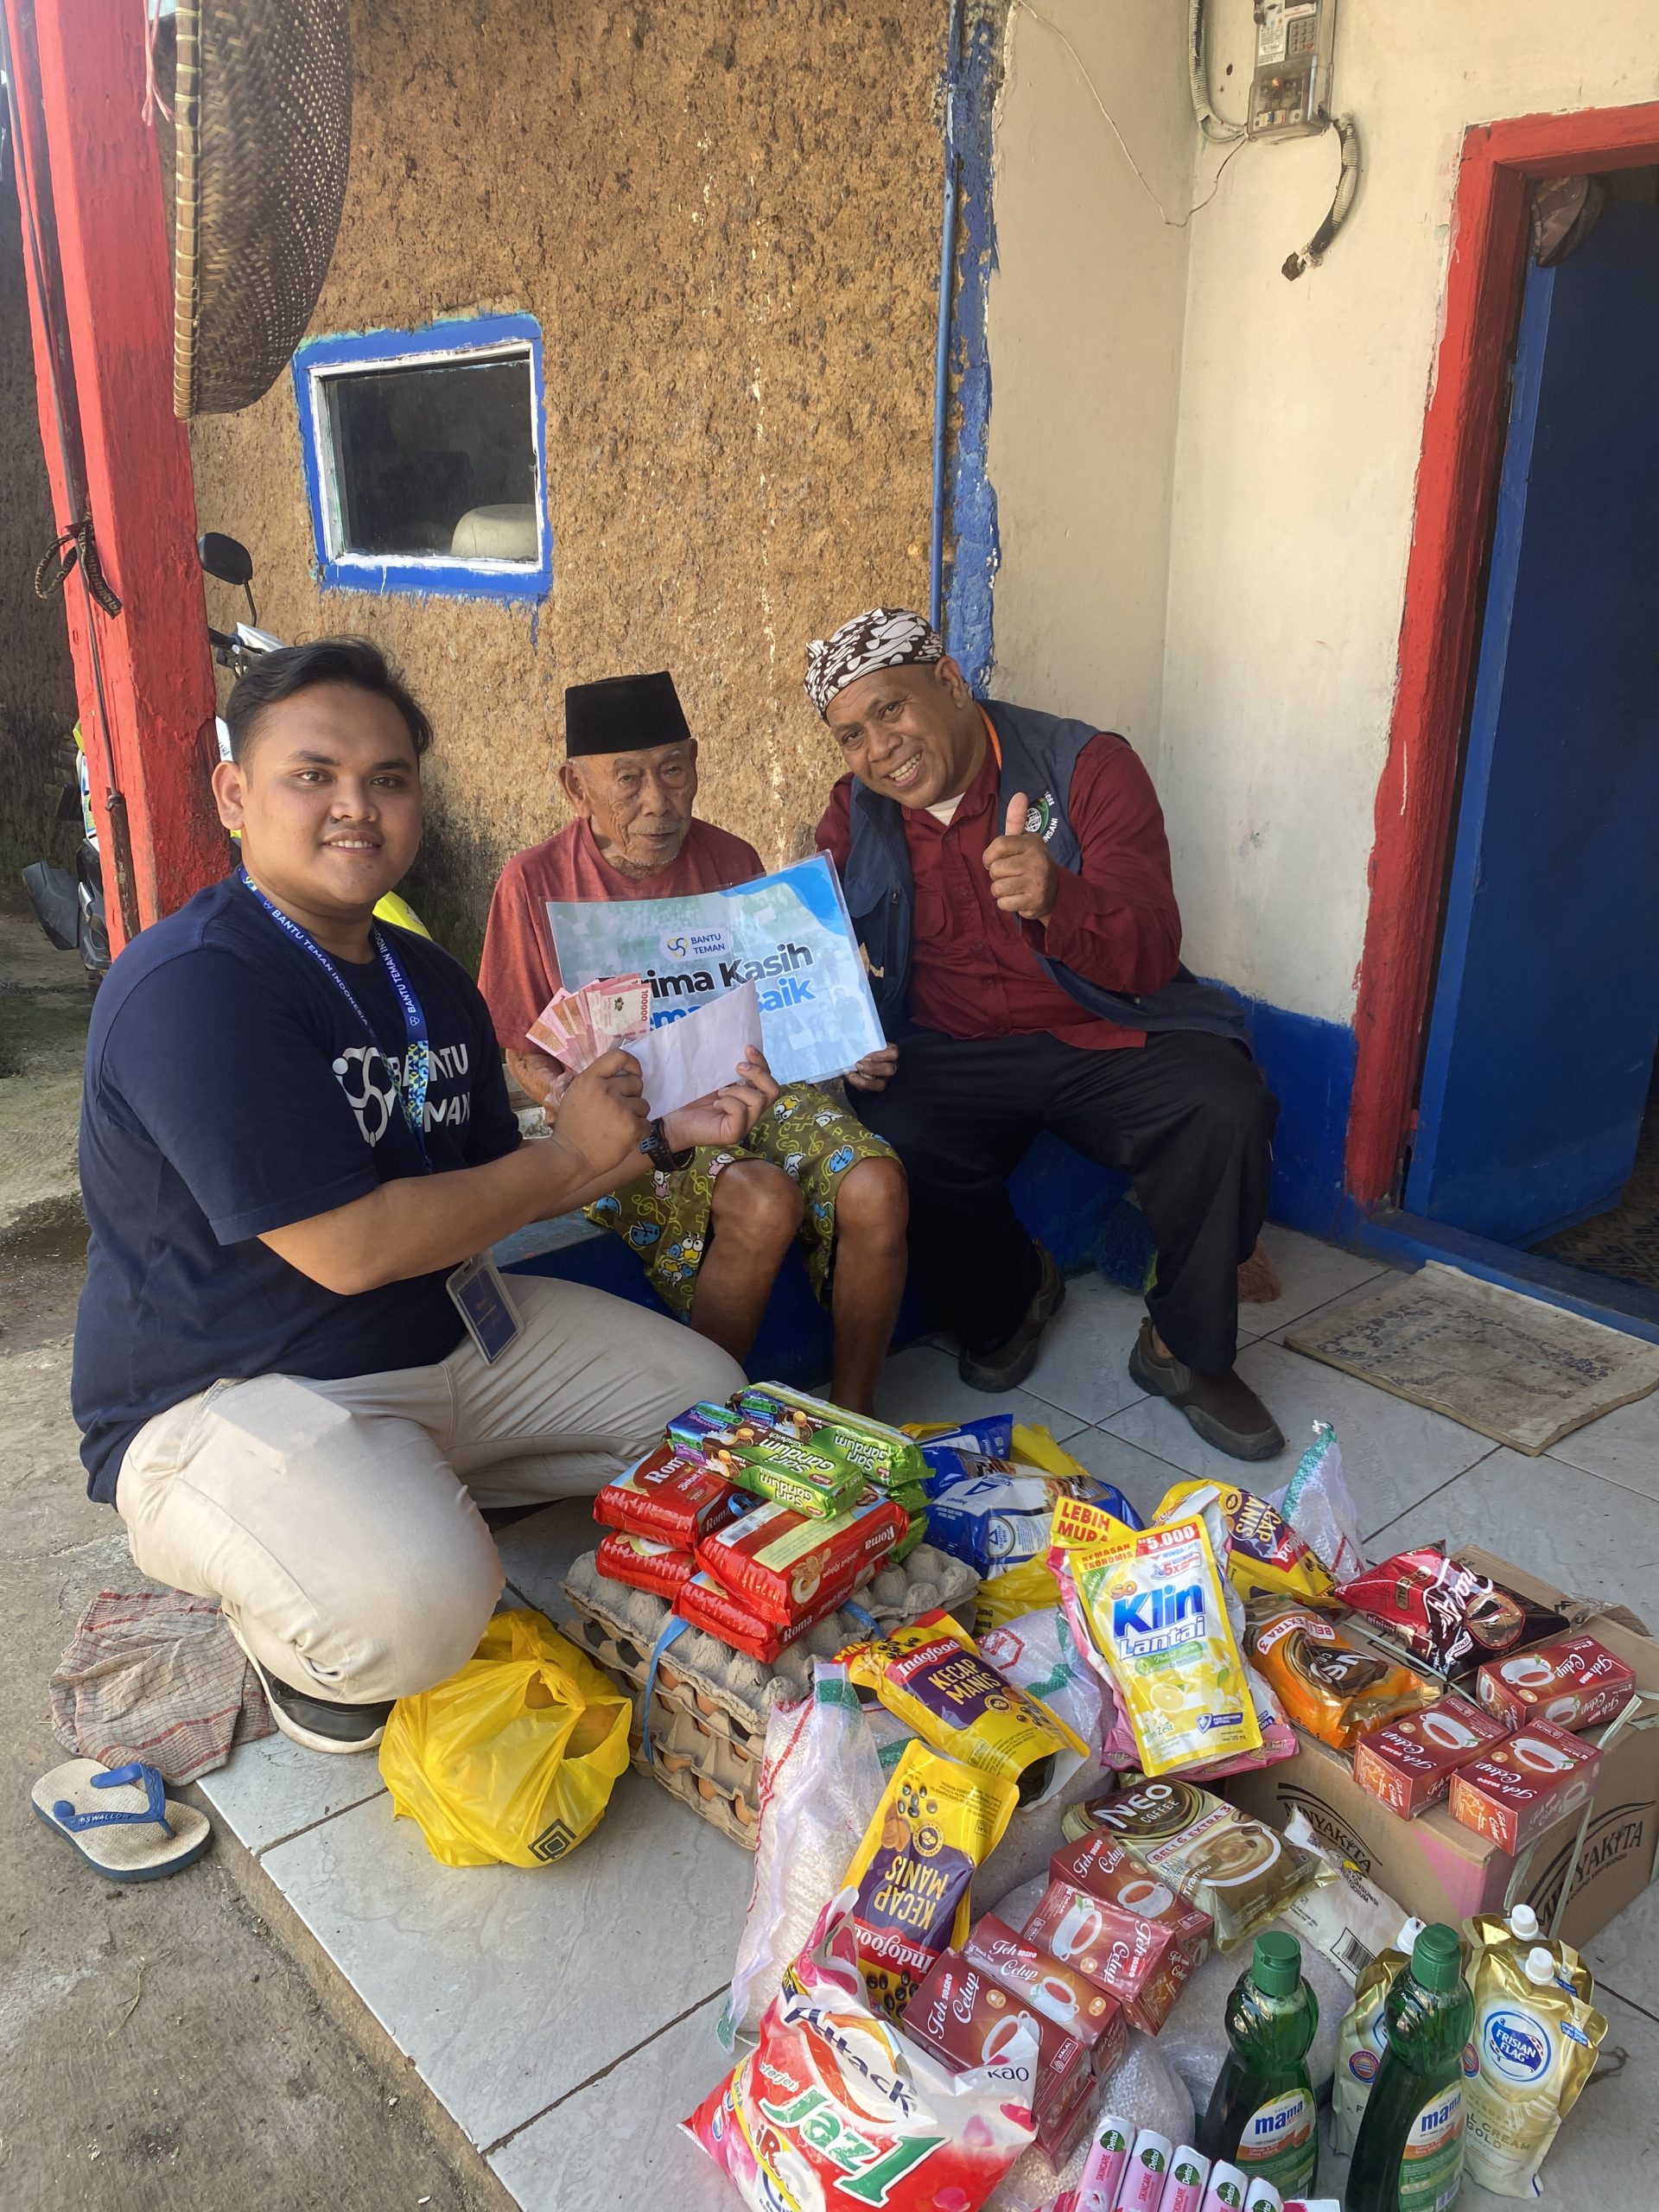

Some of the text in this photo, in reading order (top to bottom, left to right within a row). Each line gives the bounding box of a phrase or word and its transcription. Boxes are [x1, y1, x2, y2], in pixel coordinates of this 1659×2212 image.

[691, 933, 721, 944] BANTU
[693, 943, 725, 955] TEMAN
[271, 909, 367, 1027] BANTU TEMAN INDONESIA
[383, 953, 402, 983] TEMAN
[719, 942, 814, 988] Kasih
[397, 984, 416, 1014] BANTU
[640, 989, 649, 1021] 100000
[423, 1090, 470, 1133] MAN
[768, 1431, 804, 1447] Sandwich
[834, 1435, 889, 1463] Gandum
[760, 1439, 836, 1471] Gandum
[769, 1453, 811, 1474] Sari
[847, 1452, 876, 1471] Sari
[644, 1456, 686, 1484] Rom
[760, 1473, 813, 1503] Gandum
[776, 1489, 804, 1508] Sari
[706, 1509, 727, 1532] Rom
[1061, 1502, 1110, 1532] LEBIH
[1236, 1496, 1266, 1538] ANIS
[865, 1526, 895, 1549] Roma
[1082, 1543, 1131, 1563] KEMASAN
[1084, 1551, 1134, 1571] EKONOMIS
[1088, 1573, 1102, 1592] BARU
[1113, 1584, 1206, 1639] Klin
[784, 1615, 813, 1643] Roma
[1120, 1615, 1206, 1662] Lantai
[1267, 1617, 1306, 1638] EXTRA
[896, 1639, 962, 1677] Indofood
[1259, 1640, 1269, 1652] 3
[927, 1658, 979, 1691] KECAP
[1555, 1653, 1586, 1678] Celup
[1592, 1653, 1613, 1675] Teh
[944, 1672, 1001, 1706] MANIS
[1381, 1730, 1425, 1754] Celup
[1402, 1757, 1437, 1770] Teh
[1475, 1761, 1522, 1784] Celup
[1092, 1783, 1173, 1829] NEO
[1502, 1786, 1537, 1799] Teh
[86, 1813, 130, 1823] SWALLOW
[1140, 1799, 1179, 1824] COFFEE
[1153, 1842, 1178, 1862] BELI
[1187, 1815, 1222, 1837] EXTRA
[1220, 1804, 1231, 1814] 3
[1073, 1839, 1103, 1878] Teh SOSRO
[1098, 1846, 1127, 1874] Celup
[885, 1855, 950, 1901] MANIS
[1183, 1865, 1212, 1896] Tiramisu
[874, 1885, 937, 1930] KECAP
[989, 1940, 1038, 1959] Teh SOSRO
[1128, 1919, 1152, 1978] Teh SOSRO
[1001, 1959, 1039, 1981] Celup
[1103, 1941, 1130, 1985] Celup
[927, 1973, 953, 2040] Teh SOSRO
[952, 1971, 980, 2024] Celup
[1057, 2041, 1072, 2060] HALAL
[1496, 2028, 1536, 2058] FRISIAN
[1500, 2042, 1526, 2063] FLAG
[785, 2007, 915, 2119] Attack
[760, 2062, 799, 2093] eterjen
[1255, 2101, 1303, 2135] mama
[1421, 2092, 1461, 2133] mama
[1107, 2131, 1120, 2152] Dettol
[1482, 2122, 1532, 2152] CREAM
[1096, 2153, 1111, 2182] SKINCARE
[1148, 2149, 1160, 2171] Dettol
[1182, 2163, 1195, 2185] Dettol
[1138, 2172, 1153, 2202] SKINCARE
[1224, 2183, 1236, 2205] Dettol
